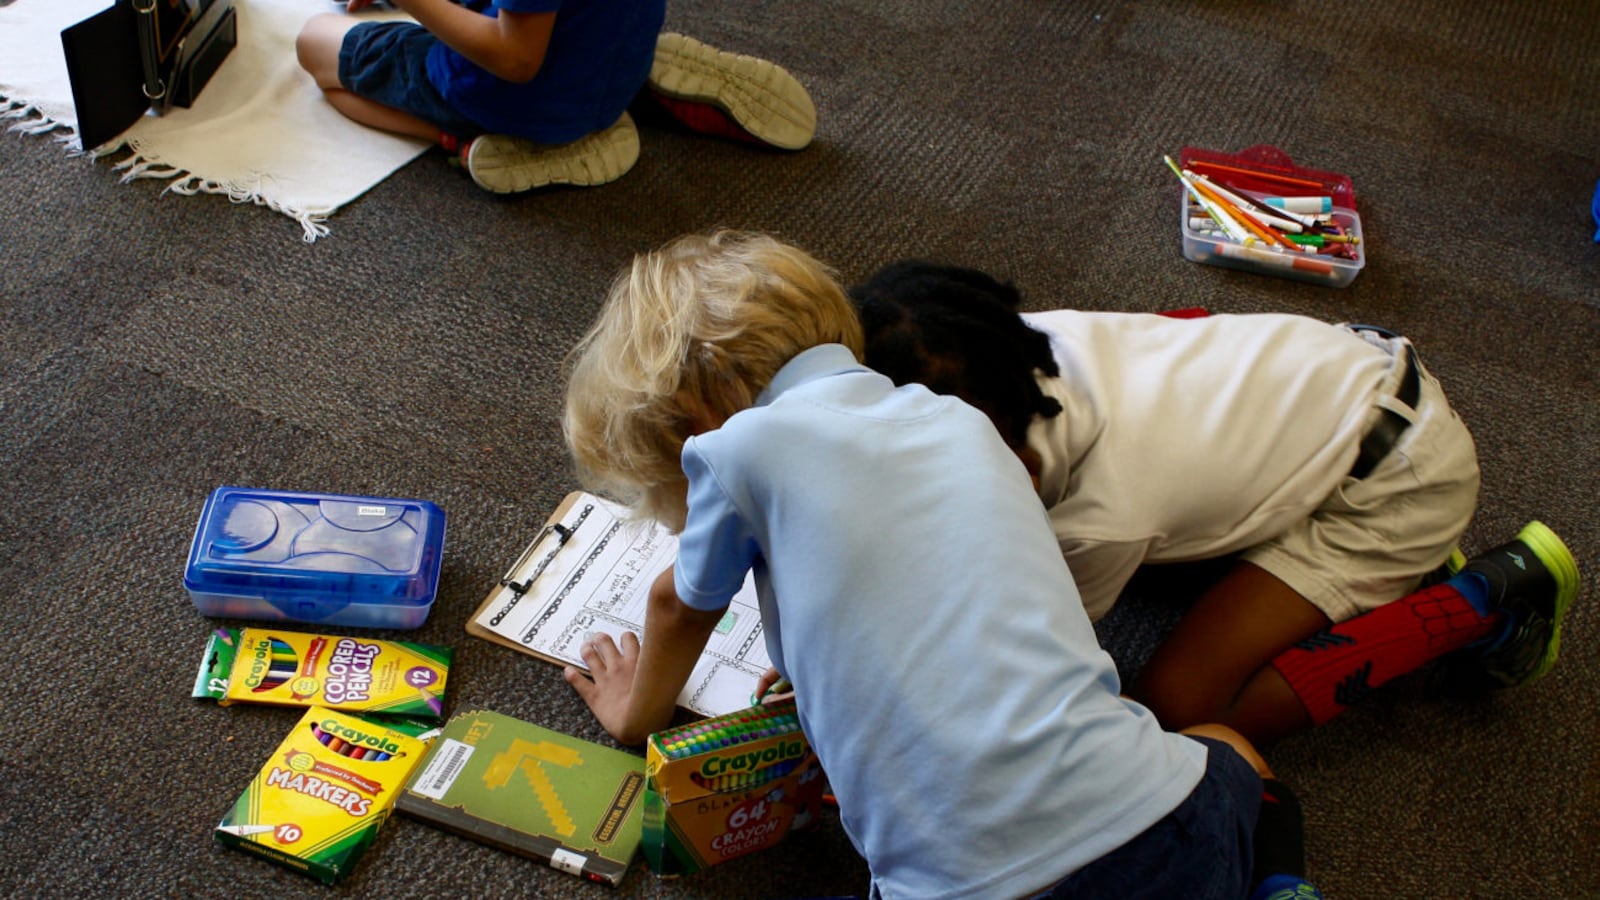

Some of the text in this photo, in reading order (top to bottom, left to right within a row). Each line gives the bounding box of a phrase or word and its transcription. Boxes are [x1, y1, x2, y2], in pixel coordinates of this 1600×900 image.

[244, 641, 271, 688] Crayola
[325, 638, 357, 704] COLORED
[346, 643, 380, 702] PENCILS
[411, 670, 431, 685] 12
[208, 677, 228, 693] 12
[319, 719, 400, 755] Crayola
[702, 741, 802, 776] Crayola
[267, 768, 373, 817] MARKERS
[729, 800, 766, 828] 64
[277, 825, 300, 842] 10
[711, 819, 778, 850] CRAYON
[721, 836, 767, 857] COLORS
